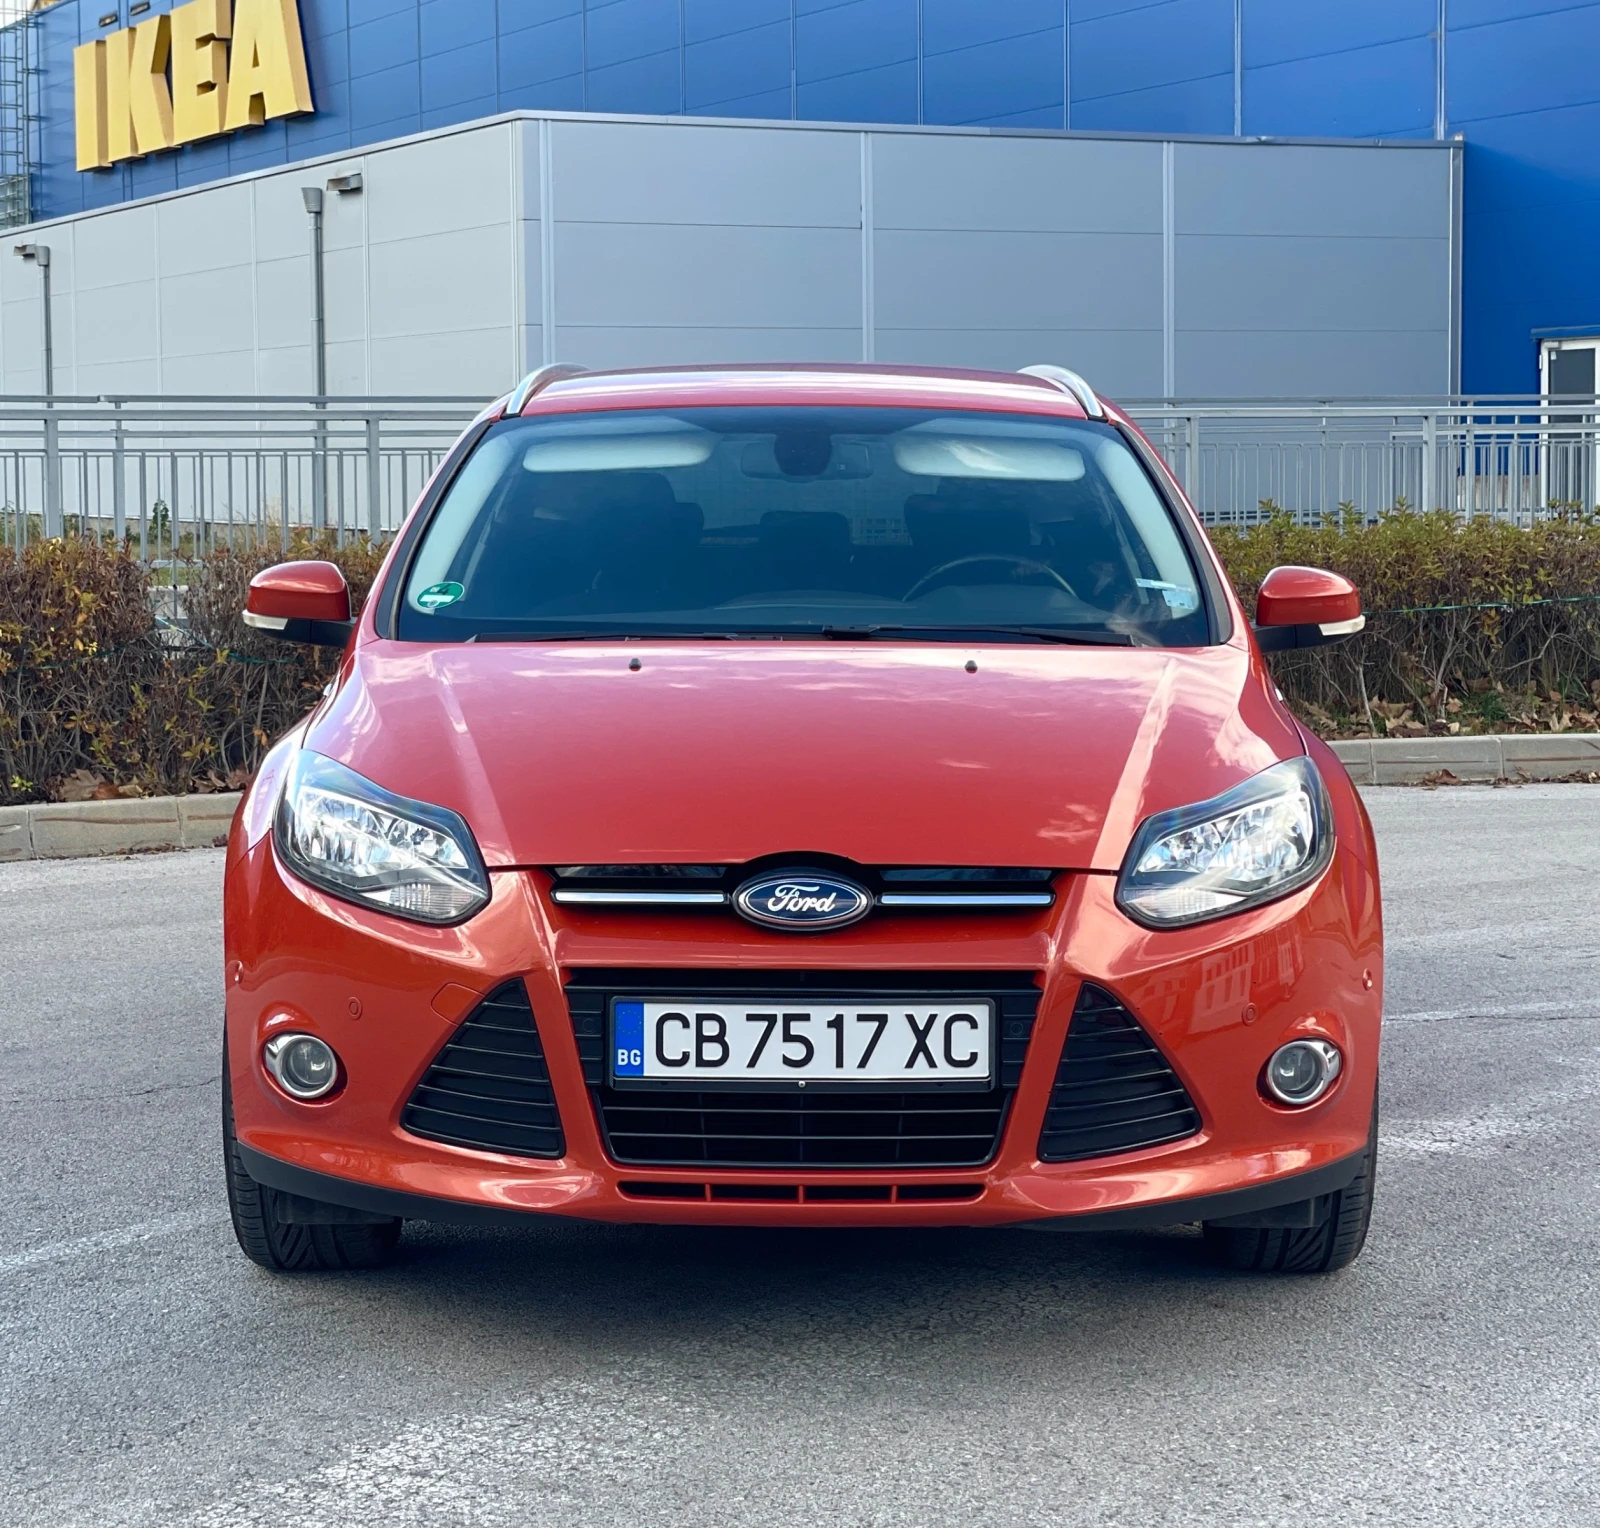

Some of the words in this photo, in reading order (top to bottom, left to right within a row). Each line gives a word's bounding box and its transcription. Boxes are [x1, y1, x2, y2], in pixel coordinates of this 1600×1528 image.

[73, 0, 314, 172] IKEA
[767, 884, 836, 913] Ford
[617, 1048, 641, 1066] BG
[655, 1012, 730, 1069] CB
[745, 1013, 889, 1070] 7517
[904, 1013, 979, 1070] XC
